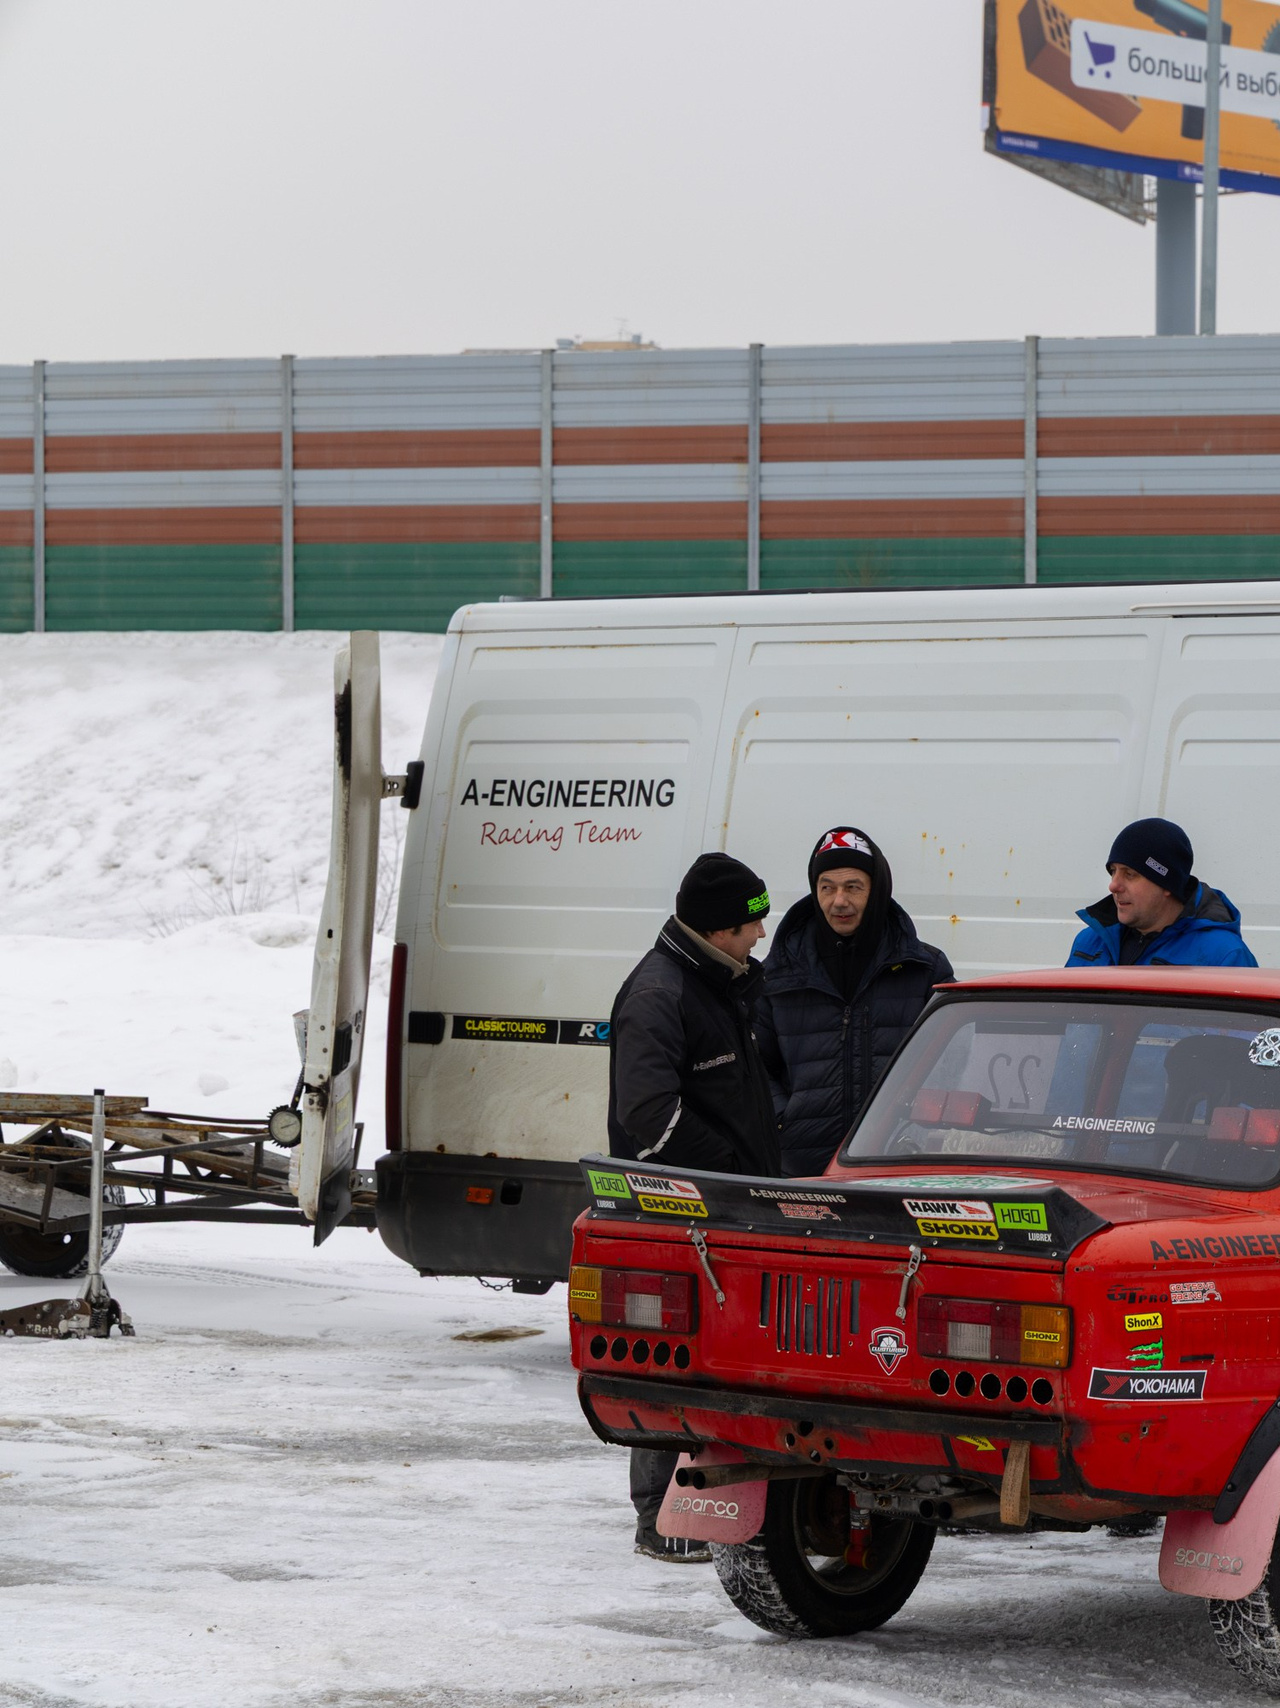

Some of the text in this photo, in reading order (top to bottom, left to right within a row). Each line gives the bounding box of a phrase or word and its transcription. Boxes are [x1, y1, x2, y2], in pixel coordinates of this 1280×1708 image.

[1128, 48, 1229, 88] большй
[461, 779, 676, 807] A-ENGINEERING
[481, 819, 642, 851] Racing Team
[465, 1020, 546, 1034] CLASSICTOURING
[1052, 1116, 1155, 1134] A-ENGINEERING
[594, 1176, 625, 1193] HOGO
[629, 1175, 675, 1191] HAWK
[749, 1188, 847, 1203] A-ENGINEERING
[641, 1198, 705, 1214] SHONX
[907, 1201, 962, 1214] HAWK
[1001, 1208, 1041, 1224] HOGO
[921, 1222, 995, 1236] SHONX
[1028, 1232, 1052, 1242] LUBREX
[1127, 1315, 1159, 1328] ShonX
[1026, 1332, 1059, 1341] SHONX
[1129, 1378, 1195, 1394] YOKOHAMA
[672, 1496, 738, 1516] sparco
[1176, 1548, 1243, 1573] sparco
